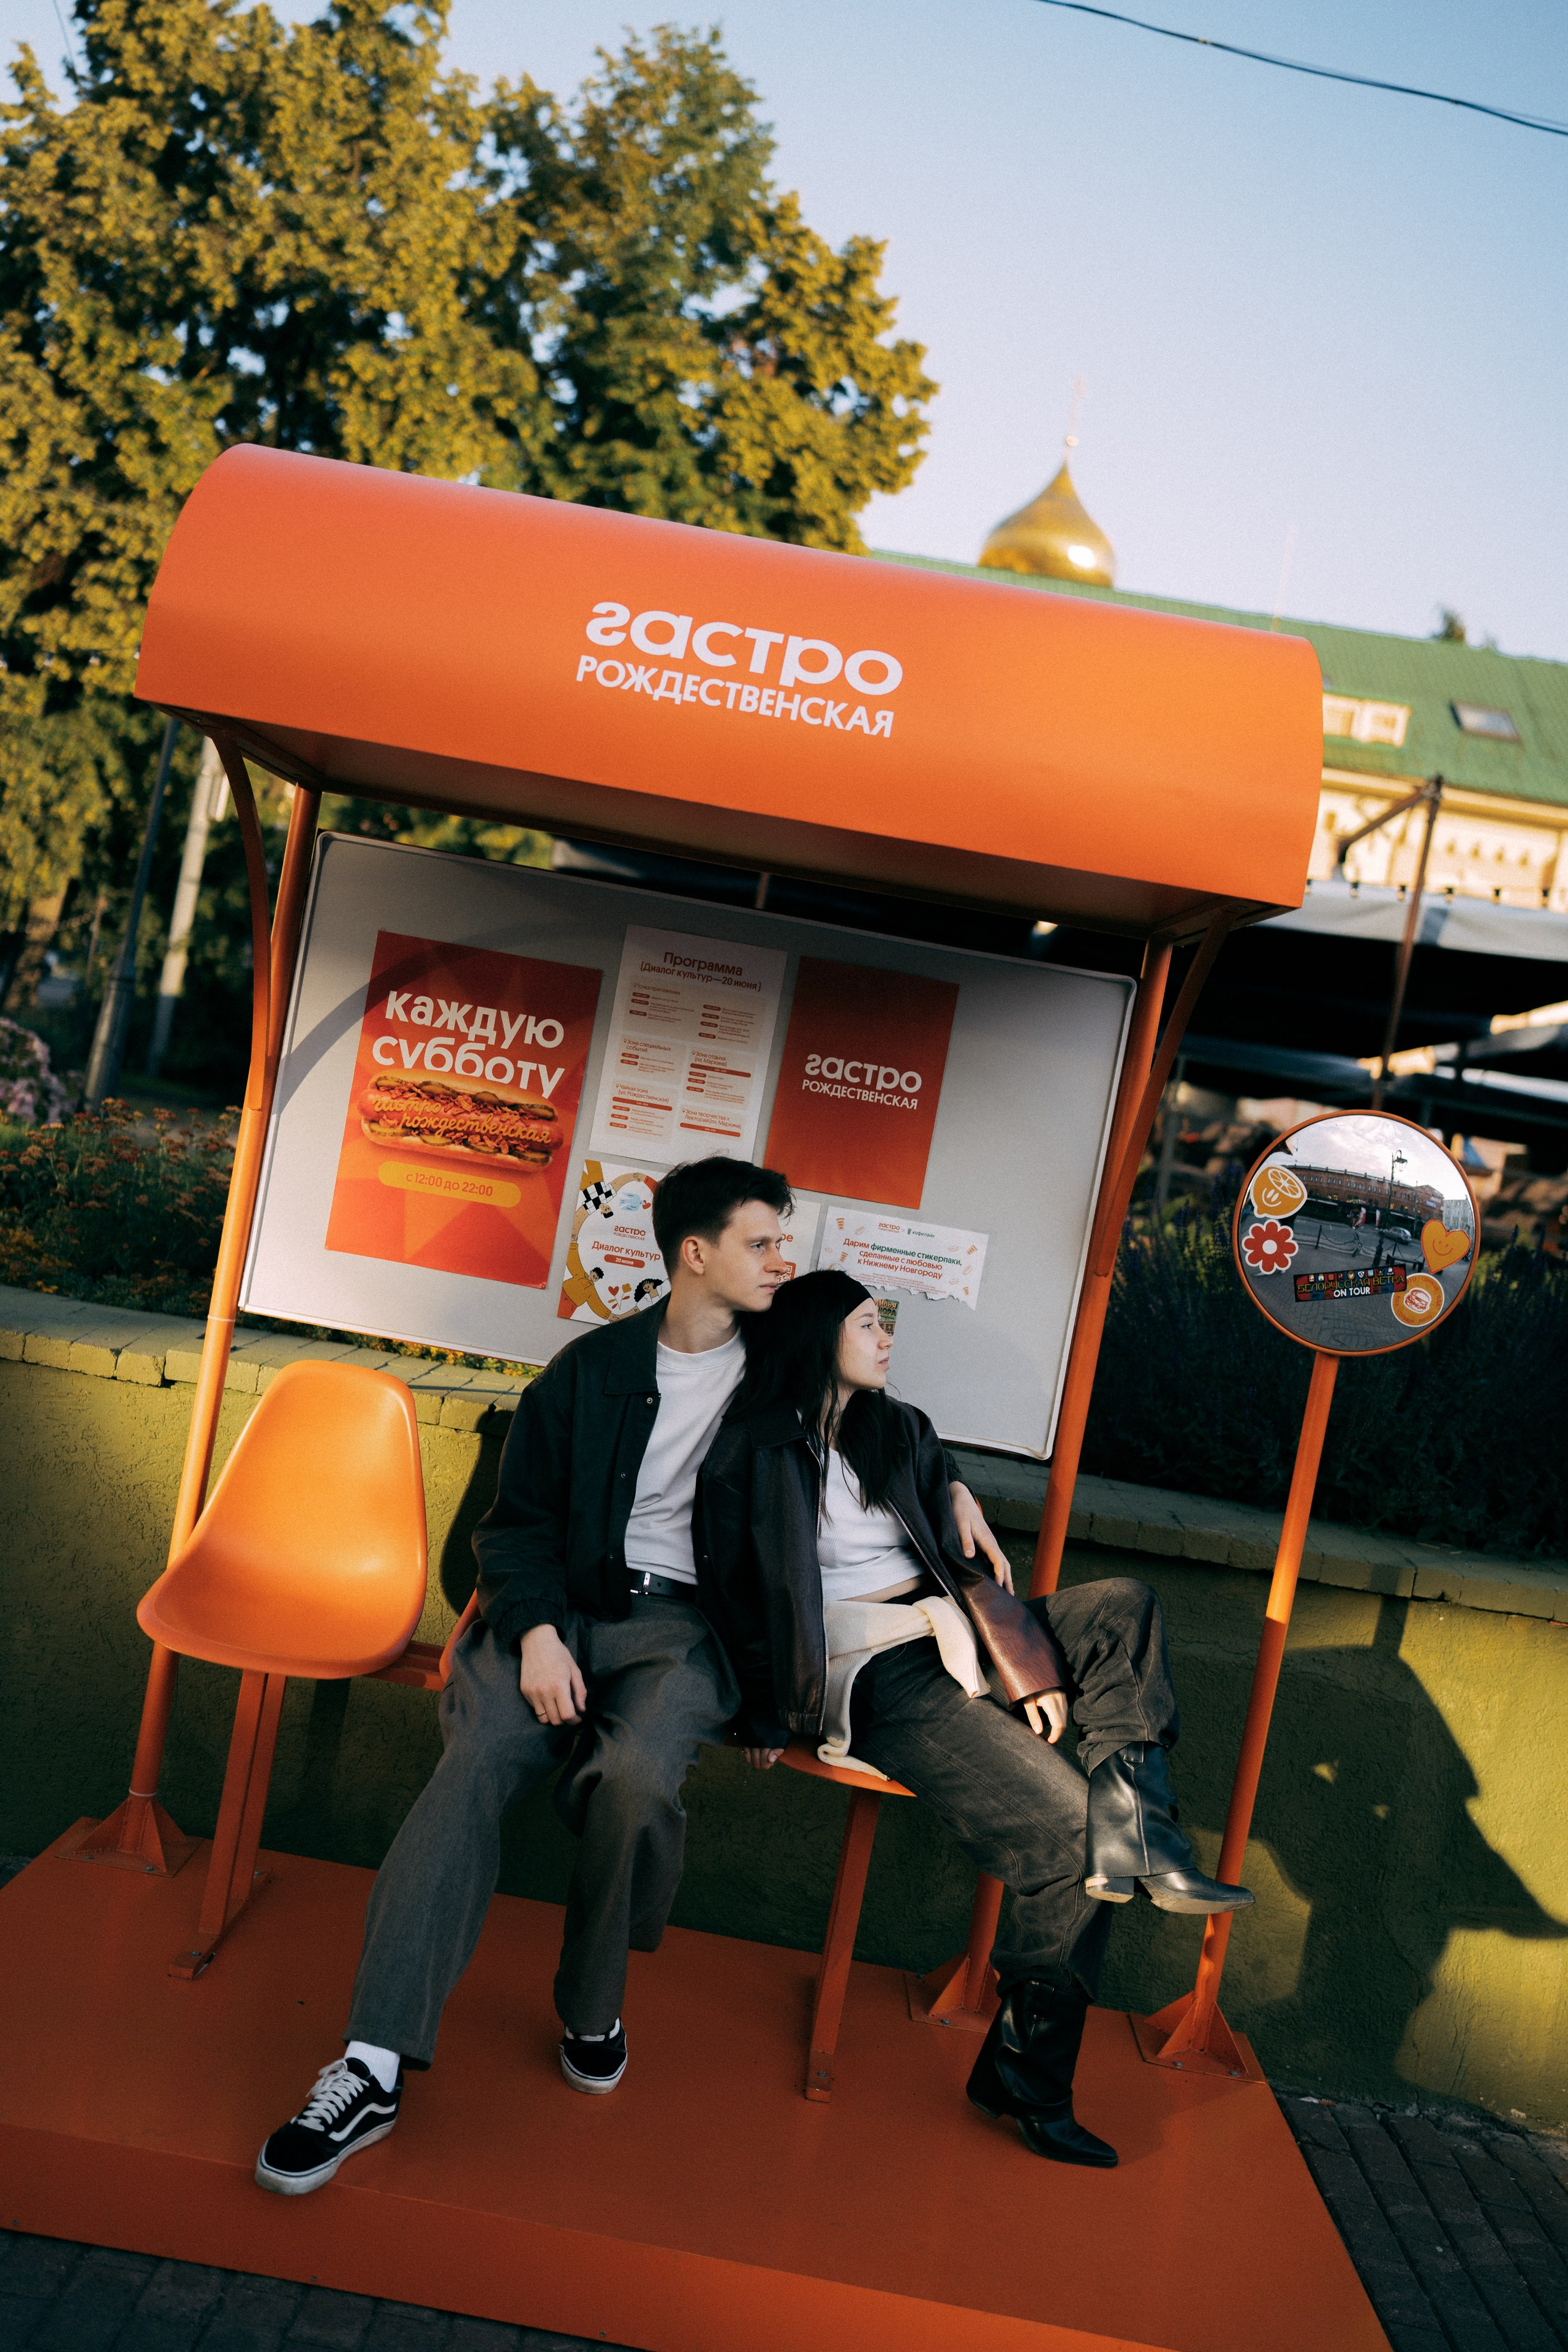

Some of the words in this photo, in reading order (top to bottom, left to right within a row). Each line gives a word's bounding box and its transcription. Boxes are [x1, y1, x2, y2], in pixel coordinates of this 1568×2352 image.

[586, 601, 903, 695] гастро
[576, 655, 894, 738] РОЖДЕСТВЕНСКАЯ
[663, 951, 743, 976] Программа
[385, 990, 564, 1049] каждую
[639, 1041, 671, 1052] специальных
[707, 1053, 726, 1061] отдыха
[372, 1036, 565, 1099] субботу
[805, 1054, 922, 1093] гастро
[619, 1084, 636, 1092] Чайная
[802, 1079, 918, 1110] РОЖДЕСТВЕНСКАЯ
[372, 1097, 442, 1116] гастро
[698, 1111, 726, 1121] творчества
[399, 1112, 551, 1144] рождественская
[684, 1114, 709, 1123] Лекторий
[406, 1174, 413, 1183] с
[415, 1172, 443, 1189] 12:00
[443, 1180, 460, 1191] до
[462, 1181, 494, 1197] 22:00
[614, 1226, 646, 1236] гастро
[592, 1241, 624, 1254] Диалог
[625, 1248, 661, 1261] культур
[843, 1238, 870, 1249] Дарим
[870, 1243, 916, 1257] фирменные
[917, 1251, 962, 1267] стикерпаки,
[859, 1250, 900, 1263] сделанные
[906, 1258, 943, 1270] любовью
[862, 1259, 899, 1273] Нижнему
[899, 1265, 943, 1280] Новгороду
[1297, 1278, 1370, 1293] БЕЛОРУССКАЯ
[1373, 1275, 1404, 1286] ВЕТКА
[1333, 1289, 1348, 1298] ON
[1349, 1287, 1371, 1296] TOUR
